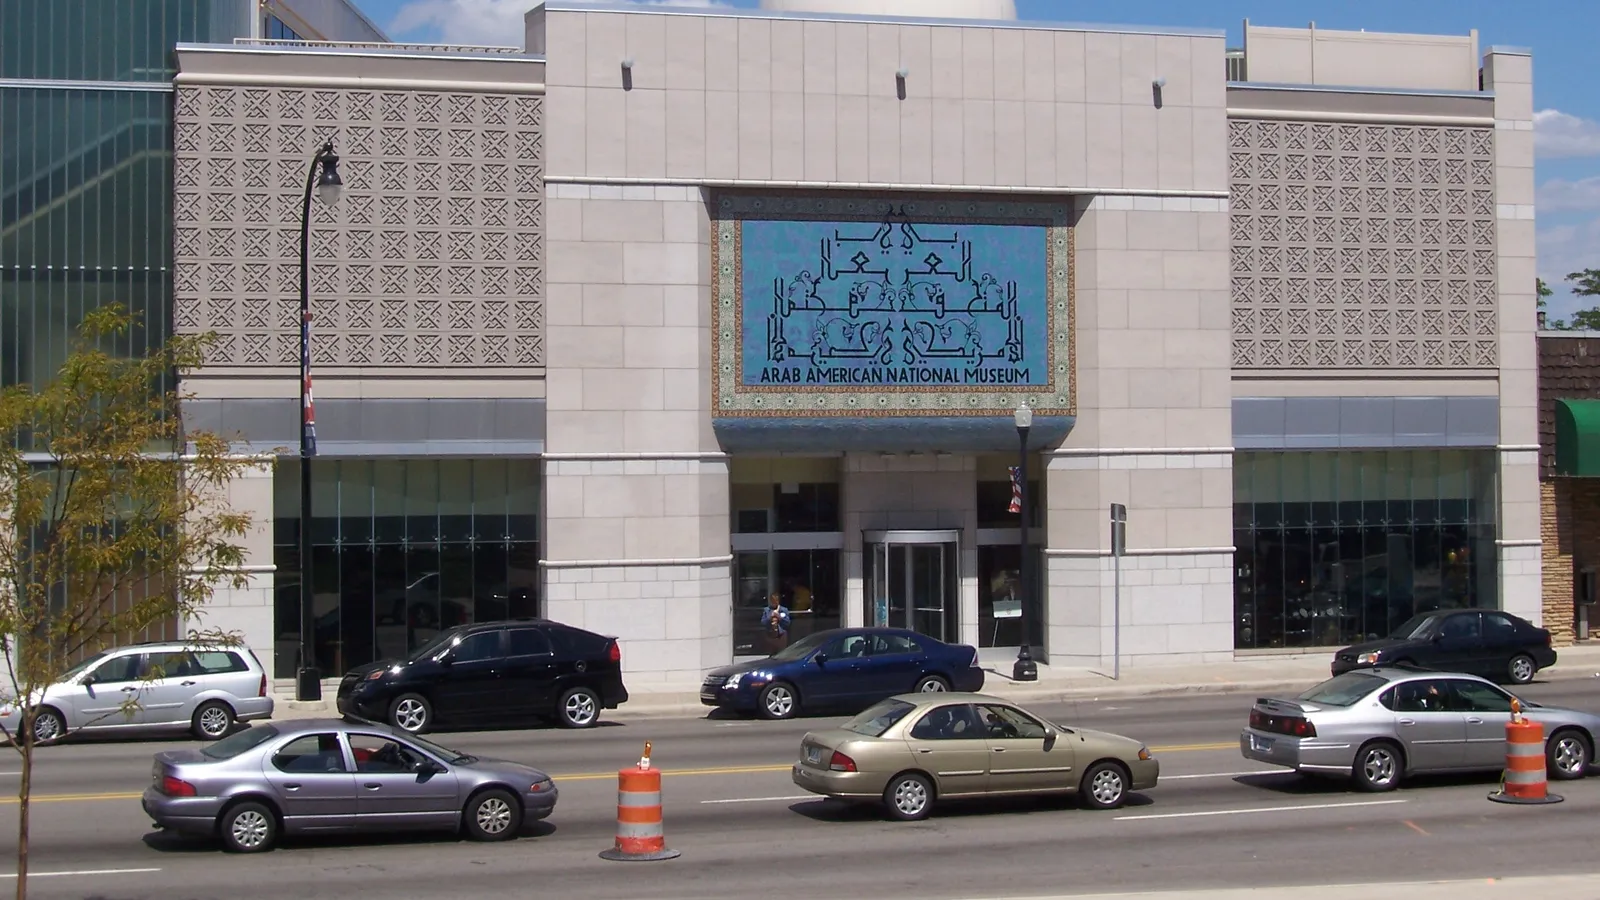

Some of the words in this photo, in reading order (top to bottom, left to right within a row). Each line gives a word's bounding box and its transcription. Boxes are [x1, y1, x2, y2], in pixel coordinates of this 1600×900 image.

[760, 368, 800, 383] ARAB
[806, 367, 882, 383] AMERICAN
[887, 367, 960, 383] NATIONAL
[964, 367, 1030, 383] MUSEUM
